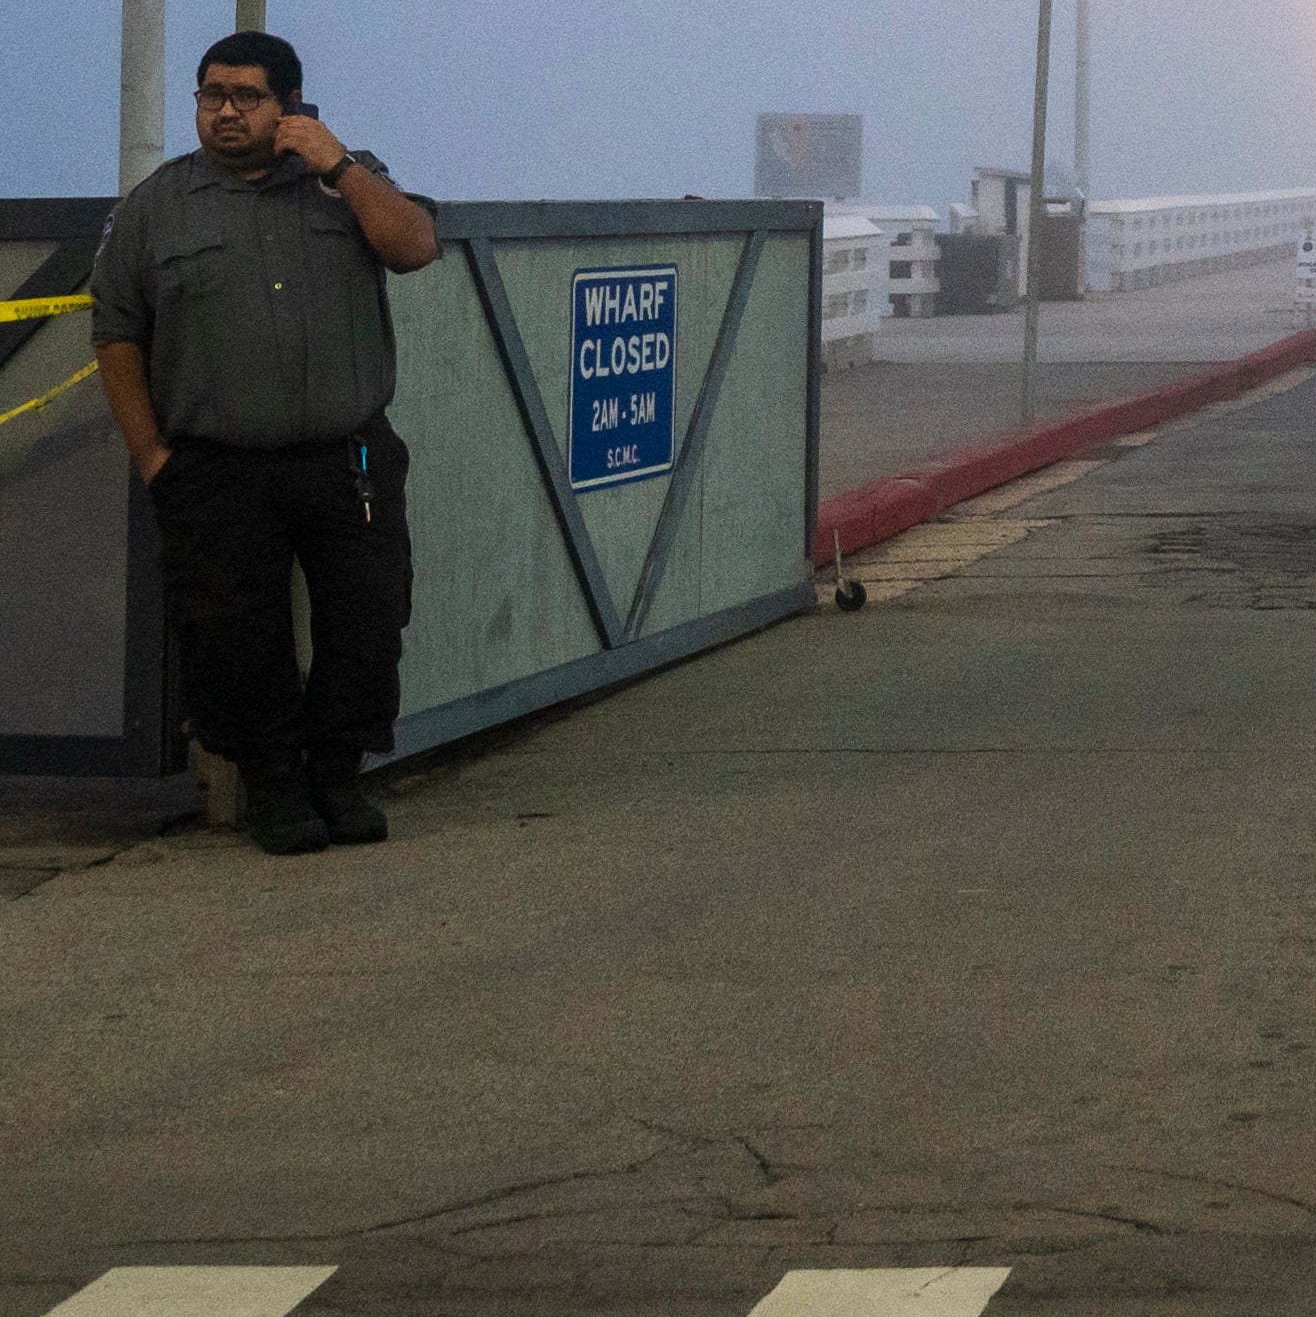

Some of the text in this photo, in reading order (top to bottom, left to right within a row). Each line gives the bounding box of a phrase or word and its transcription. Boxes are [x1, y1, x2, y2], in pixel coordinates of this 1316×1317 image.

[585, 281, 668, 326] WHARF
[580, 332, 670, 380] CLOSED
[592, 397, 618, 432] 2AM
[631, 392, 656, 426] 5AM
